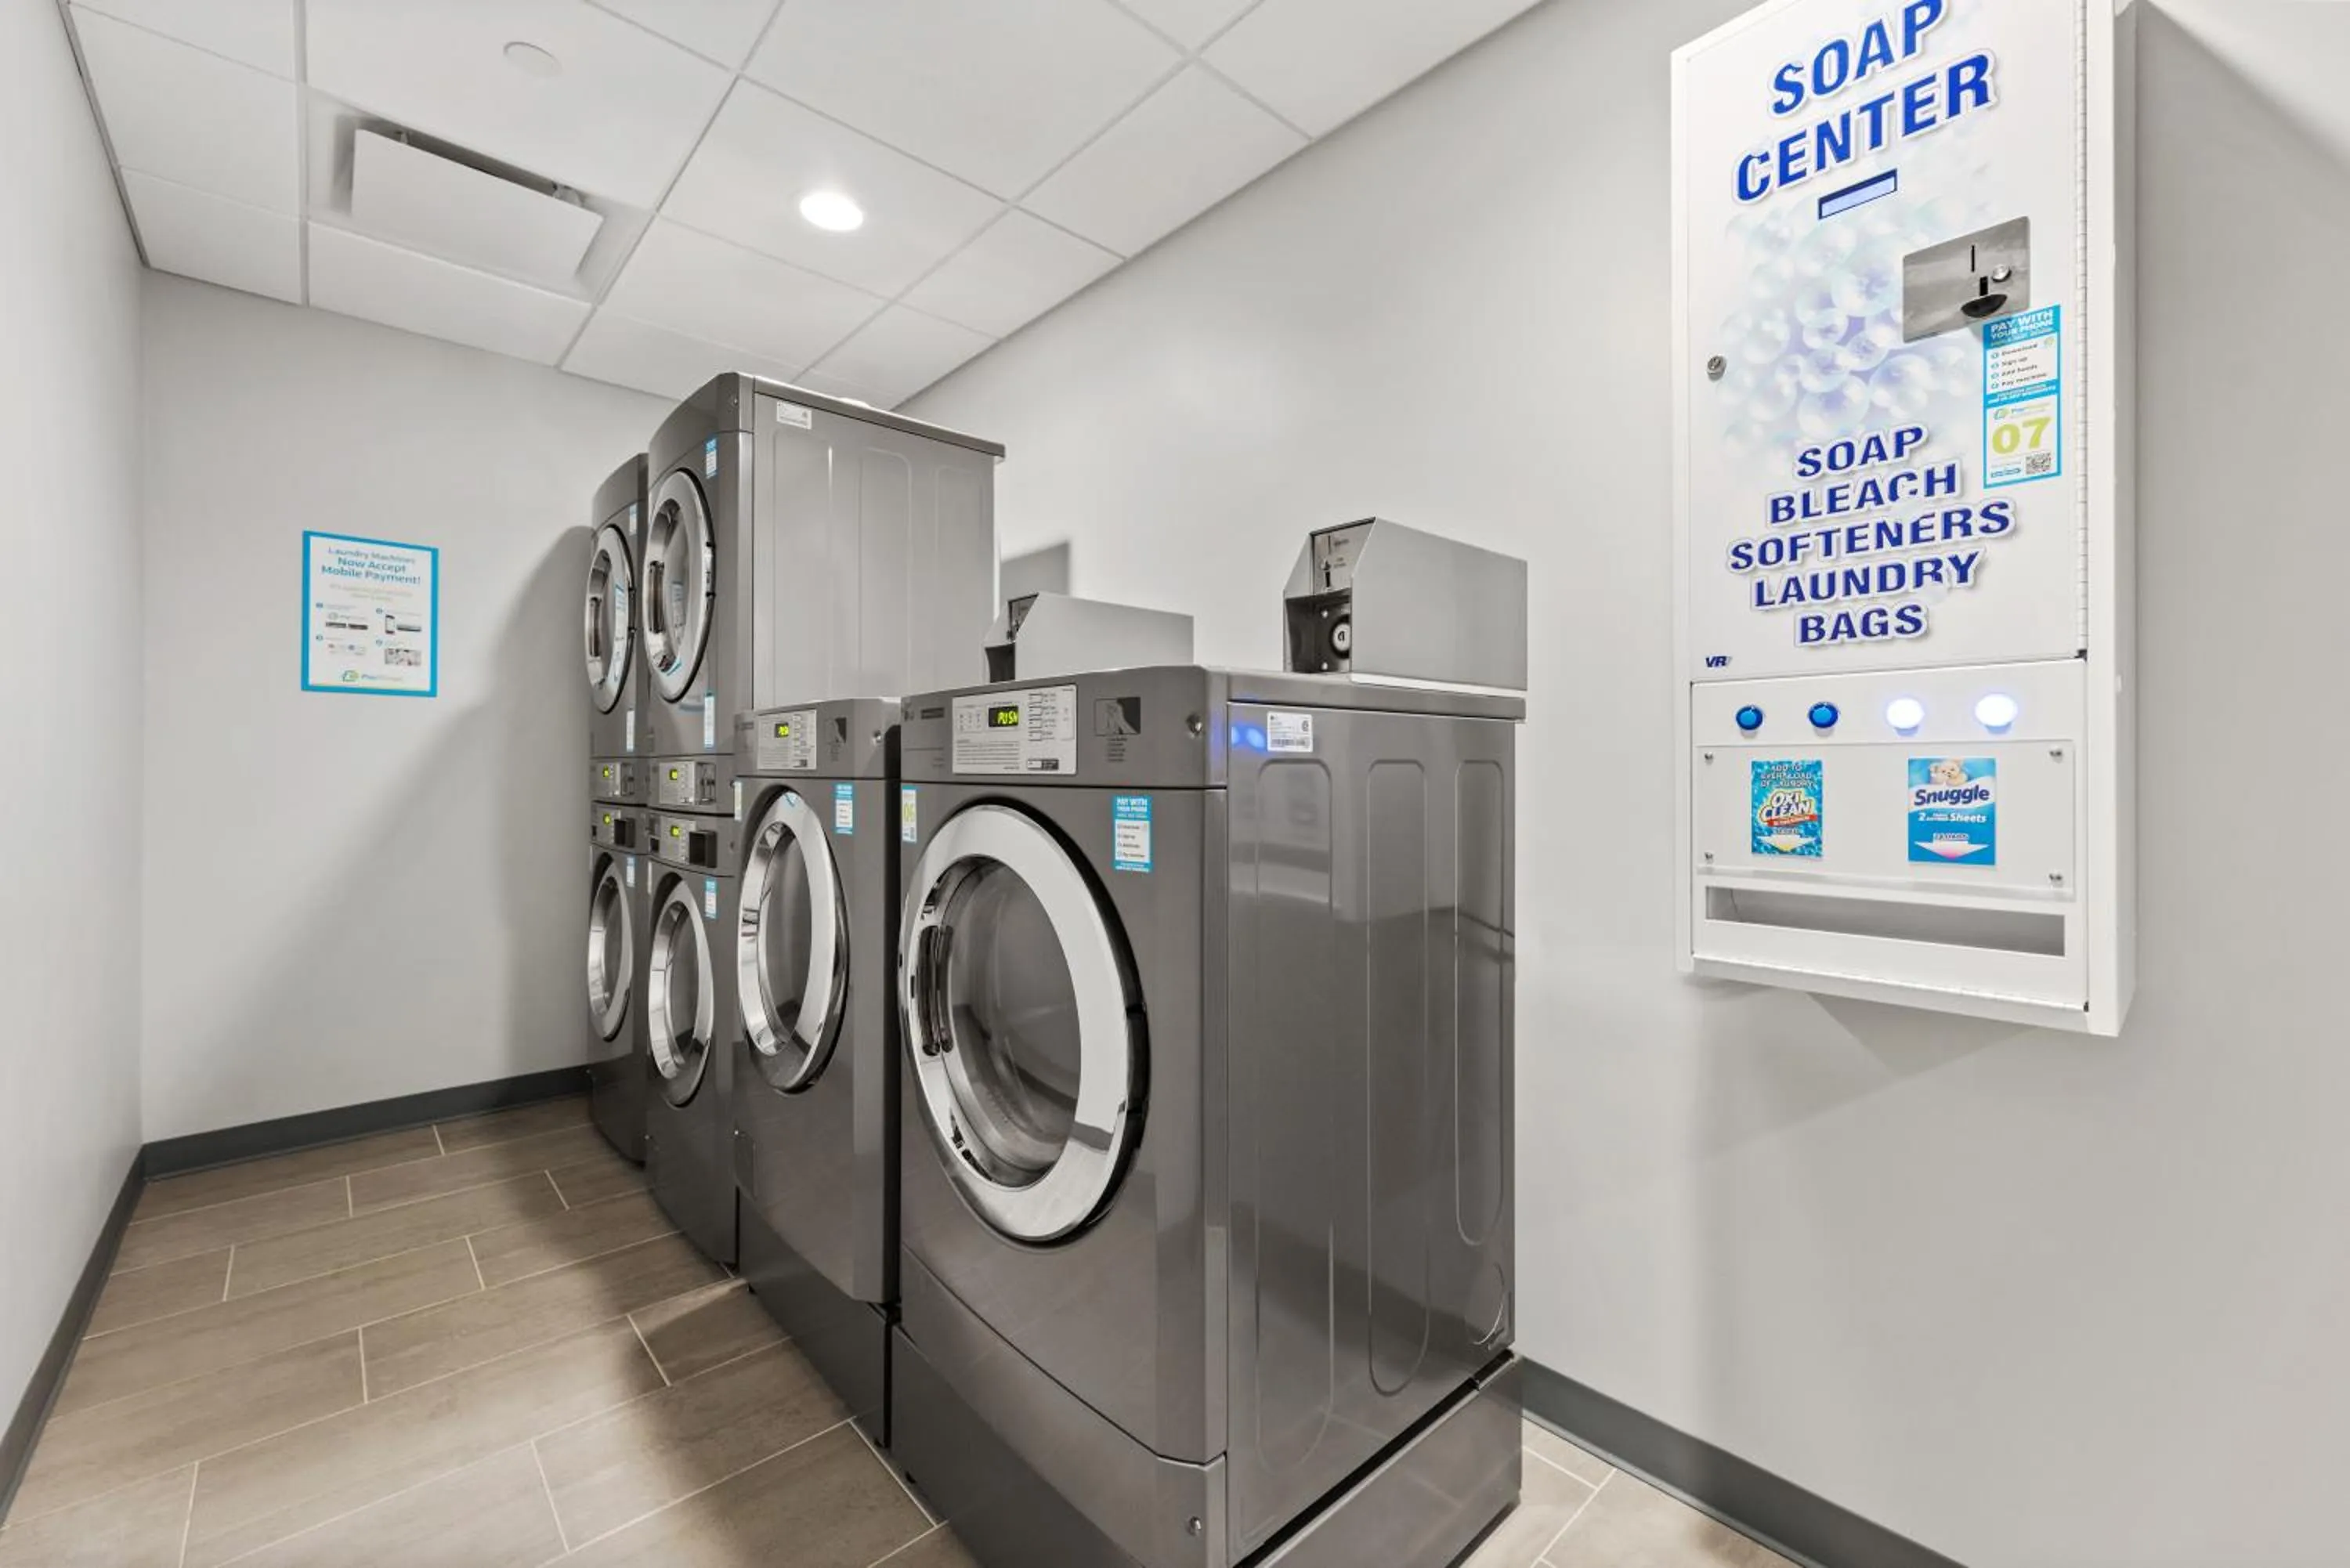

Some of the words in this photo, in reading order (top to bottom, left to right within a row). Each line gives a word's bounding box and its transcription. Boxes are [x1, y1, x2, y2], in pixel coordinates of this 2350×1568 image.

[1773, 0, 1947, 115] SOAP
[1737, 54, 1994, 201] CENTER
[1990, 319, 2015, 334] PAY
[2016, 309, 2053, 327] WITH
[1992, 416, 2052, 455] 07
[1796, 426, 1925, 478] SOAP
[1770, 464, 1958, 524] BLEACH
[1730, 501, 2010, 570] SOFTENERS
[328, 547, 369, 559] Laundry
[338, 557, 366, 567] Now
[367, 562, 407, 573] Accept
[321, 565, 363, 578] Mobile
[365, 572, 421, 584] Payment!
[1755, 551, 1979, 607] LAUNDRY
[1799, 604, 1924, 643] BAGS
[1760, 801, 1811, 821] CLEAN
[1772, 792, 1801, 808] OXI
[1914, 784, 1990, 806] Snuggle
[1918, 812, 1927, 822] 2
[1949, 812, 1988, 823] Sheets
